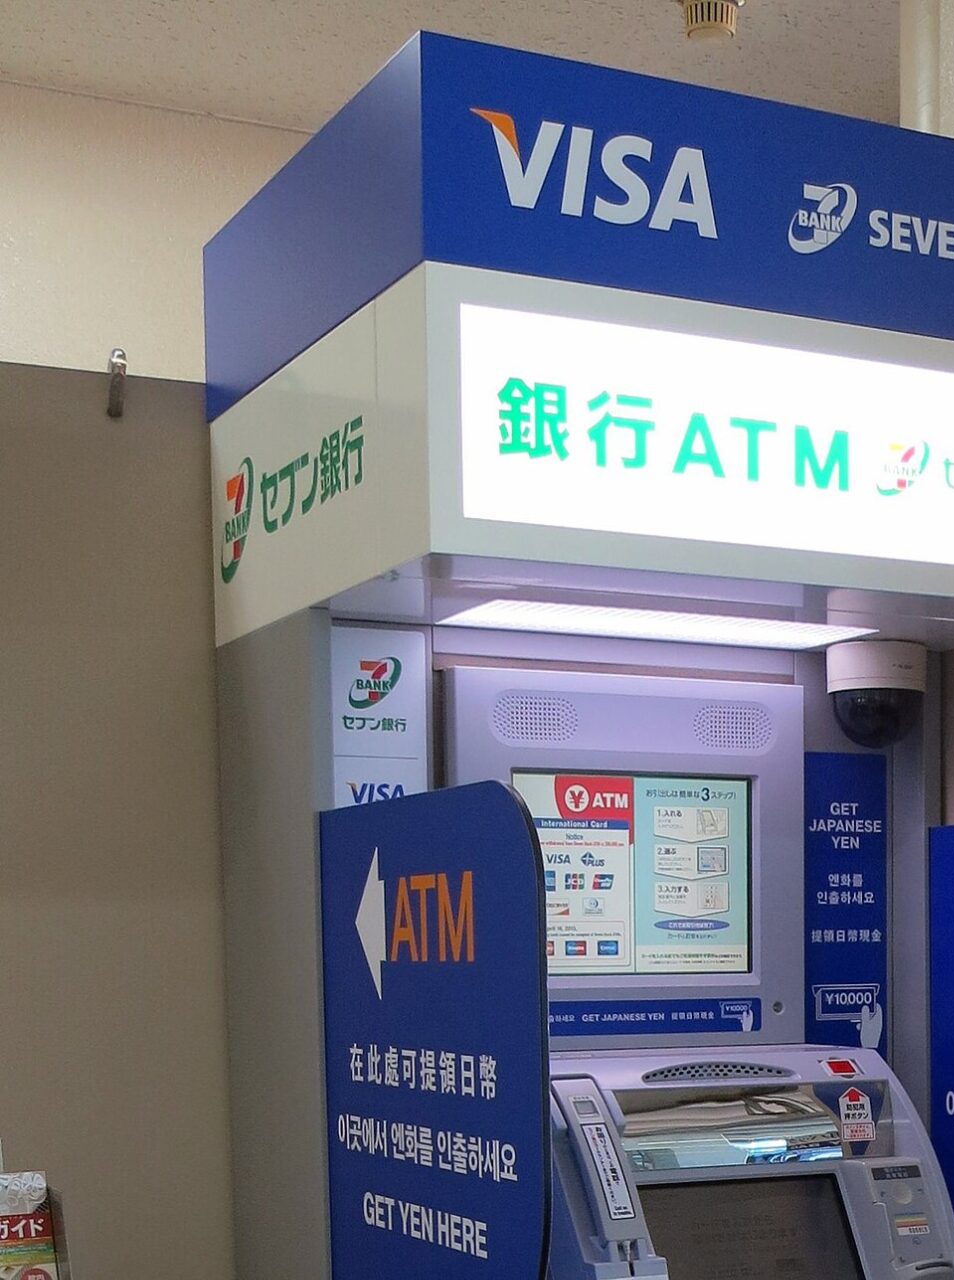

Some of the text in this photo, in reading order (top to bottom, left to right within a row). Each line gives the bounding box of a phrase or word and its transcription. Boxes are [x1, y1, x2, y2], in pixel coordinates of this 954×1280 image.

[470, 107, 718, 240] VISA
[798, 208, 843, 233] BANK
[356, 678, 391, 691] BANK
[346, 782, 406, 804] VISA
[592, 793, 629, 809] ATM
[830, 802, 859, 816] GET
[541, 820, 608, 829] International Card
[809, 819, 882, 833] JAPANESE
[831, 836, 860, 849] YEN
[546, 854, 571, 865] VISA
[816, 891, 875, 905] 인출하세요
[390, 870, 475, 962] ATM
[581, 1012, 665, 1022] GET JAPANESE YEN
[349, 1043, 497, 1100] 在此處可提領日幣
[338, 1113, 518, 1182] 이곳에서 엔화를 인출하세요
[363, 1191, 488, 1260] GET YEN HERE
